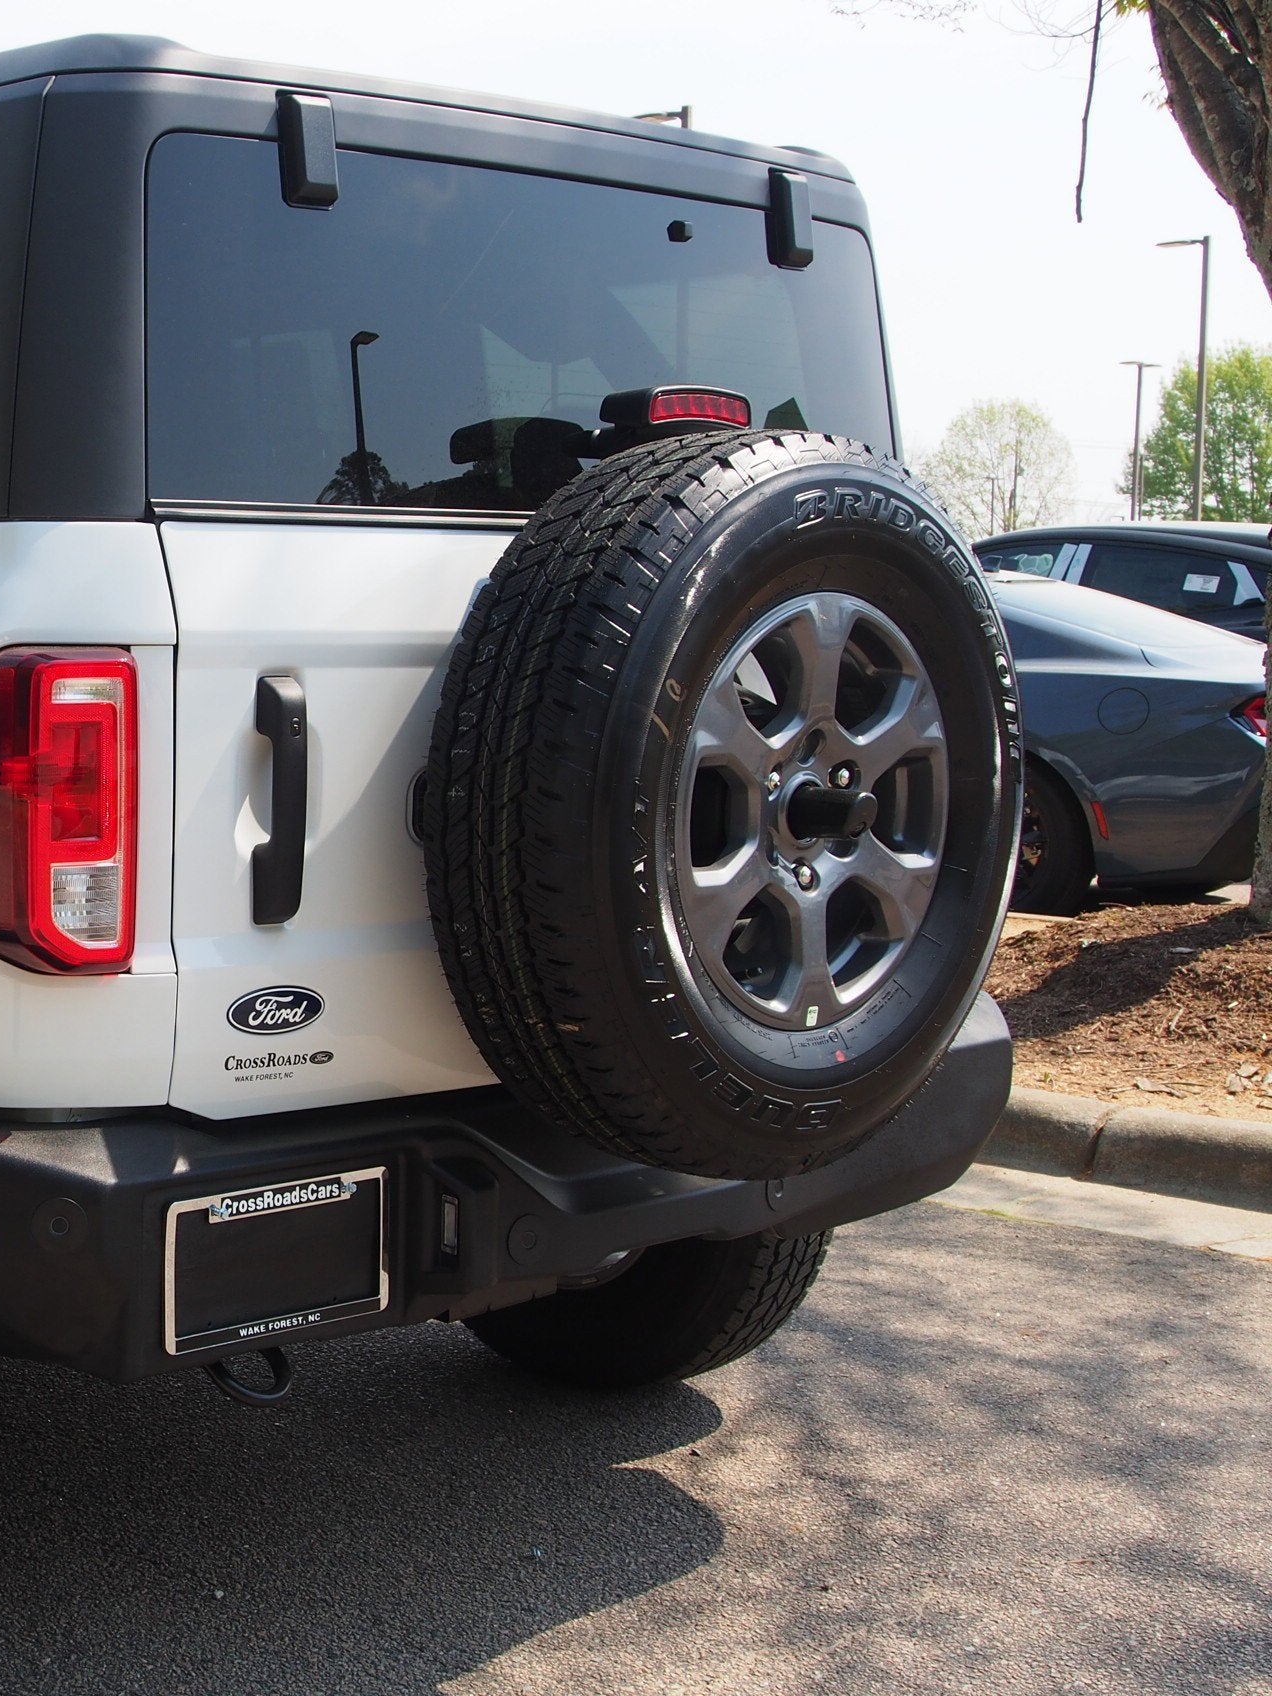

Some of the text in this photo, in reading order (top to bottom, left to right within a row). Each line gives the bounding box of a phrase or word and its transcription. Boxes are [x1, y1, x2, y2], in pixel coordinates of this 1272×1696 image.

[248, 995, 308, 1026] Ford
[255, 1073, 282, 1081] FOREST,
[221, 1183, 340, 1216] CrossRoadsCars
[239, 1313, 322, 1337] WAKE FOREST, NC
